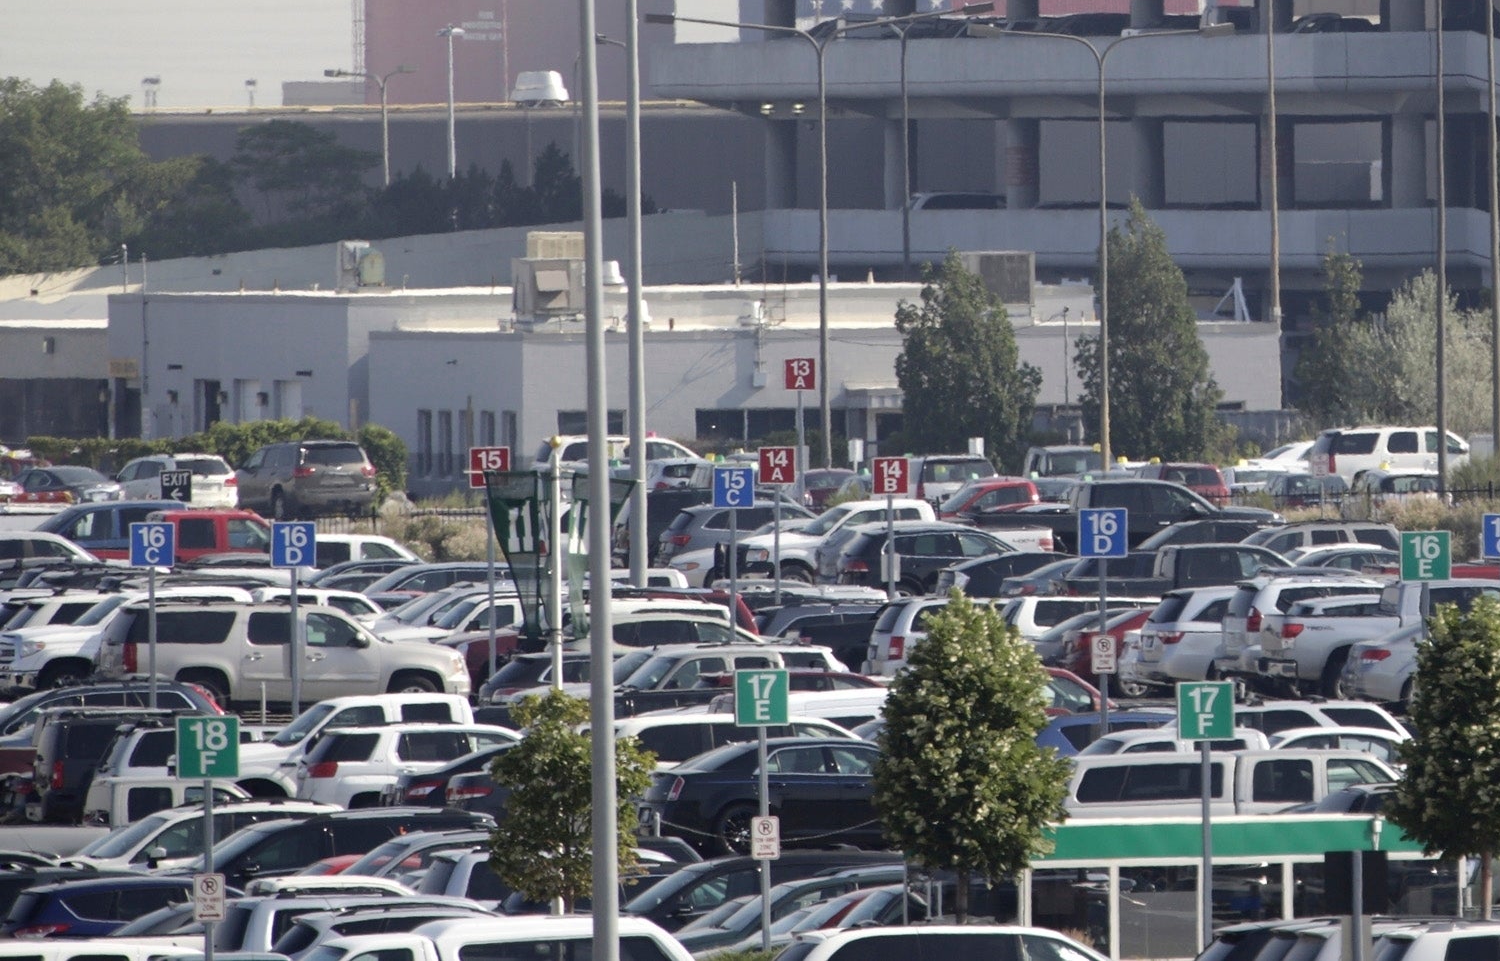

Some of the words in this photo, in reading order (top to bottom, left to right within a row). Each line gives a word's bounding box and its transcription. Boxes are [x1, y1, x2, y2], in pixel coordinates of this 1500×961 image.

[790, 360, 810, 377] 13
[794, 374, 806, 387] A
[477, 450, 502, 469] 15
[765, 449, 789, 468] 14
[162, 472, 190, 486] EXIT
[771, 468, 784, 481] A
[879, 460, 903, 479] 14
[720, 470, 746, 490] 15
[883, 476, 899, 492] B
[725, 487, 741, 506] C
[1088, 511, 1118, 536] 16
[138, 525, 166, 548] 16
[279, 525, 308, 548] 16
[1093, 533, 1113, 555] D
[144, 545, 161, 564] C
[285, 545, 303, 565] D
[1409, 534, 1441, 565] 16
[1418, 562, 1434, 579] E
[747, 672, 778, 701] 17
[1188, 684, 1220, 714] 17
[754, 698, 771, 721] E
[1196, 711, 1215, 735] F
[189, 719, 229, 751] 18
[199, 750, 218, 775] F
